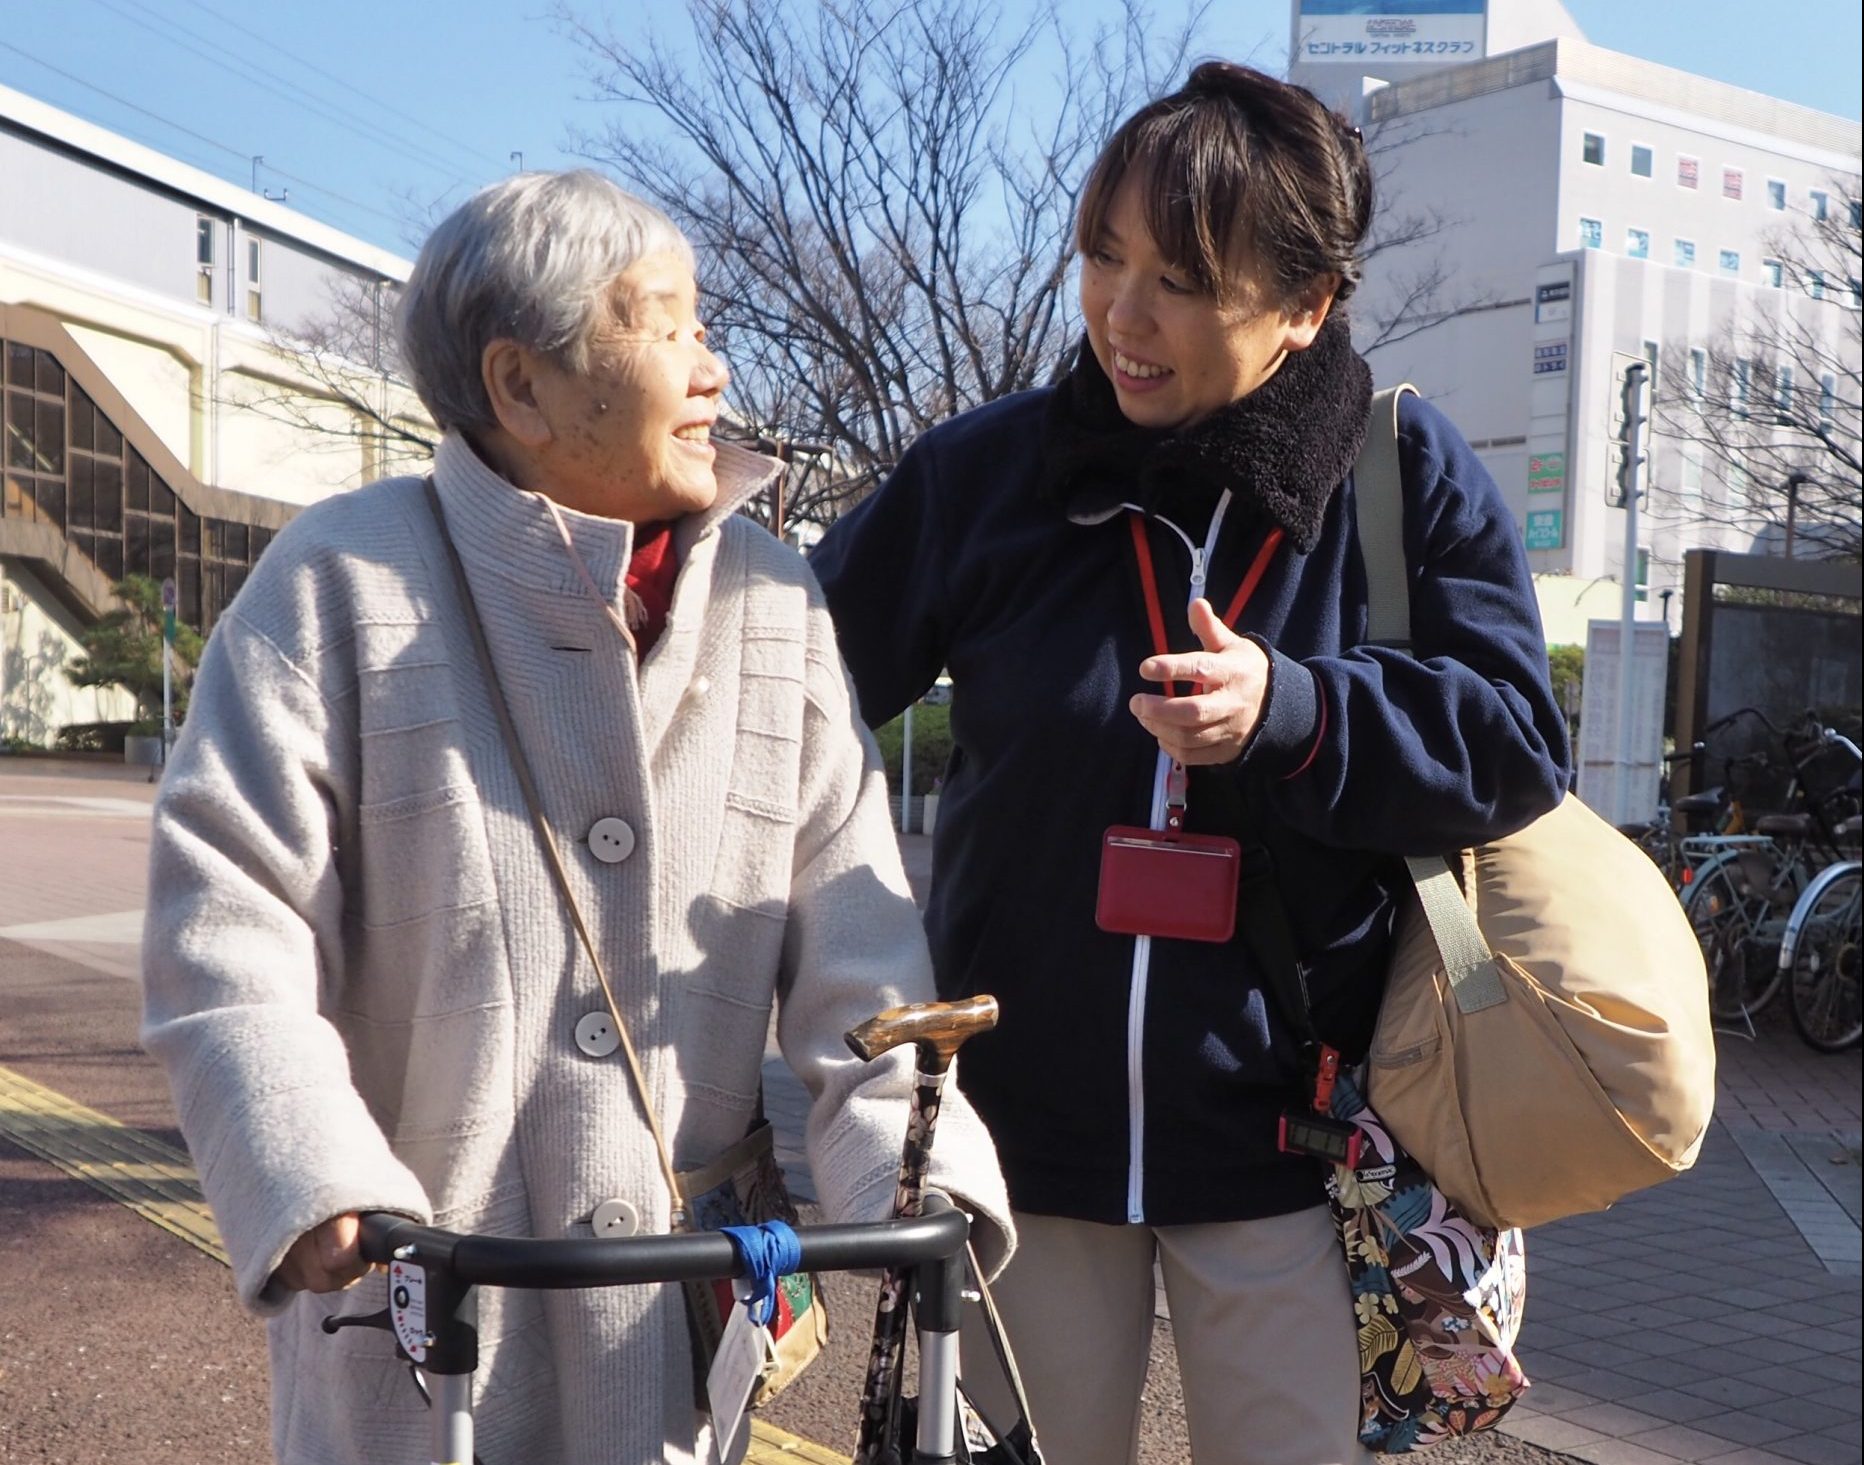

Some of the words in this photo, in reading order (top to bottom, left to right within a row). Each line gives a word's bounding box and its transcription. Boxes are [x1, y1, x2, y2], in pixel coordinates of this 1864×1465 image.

[1307, 41, 1366, 55] セントラル
